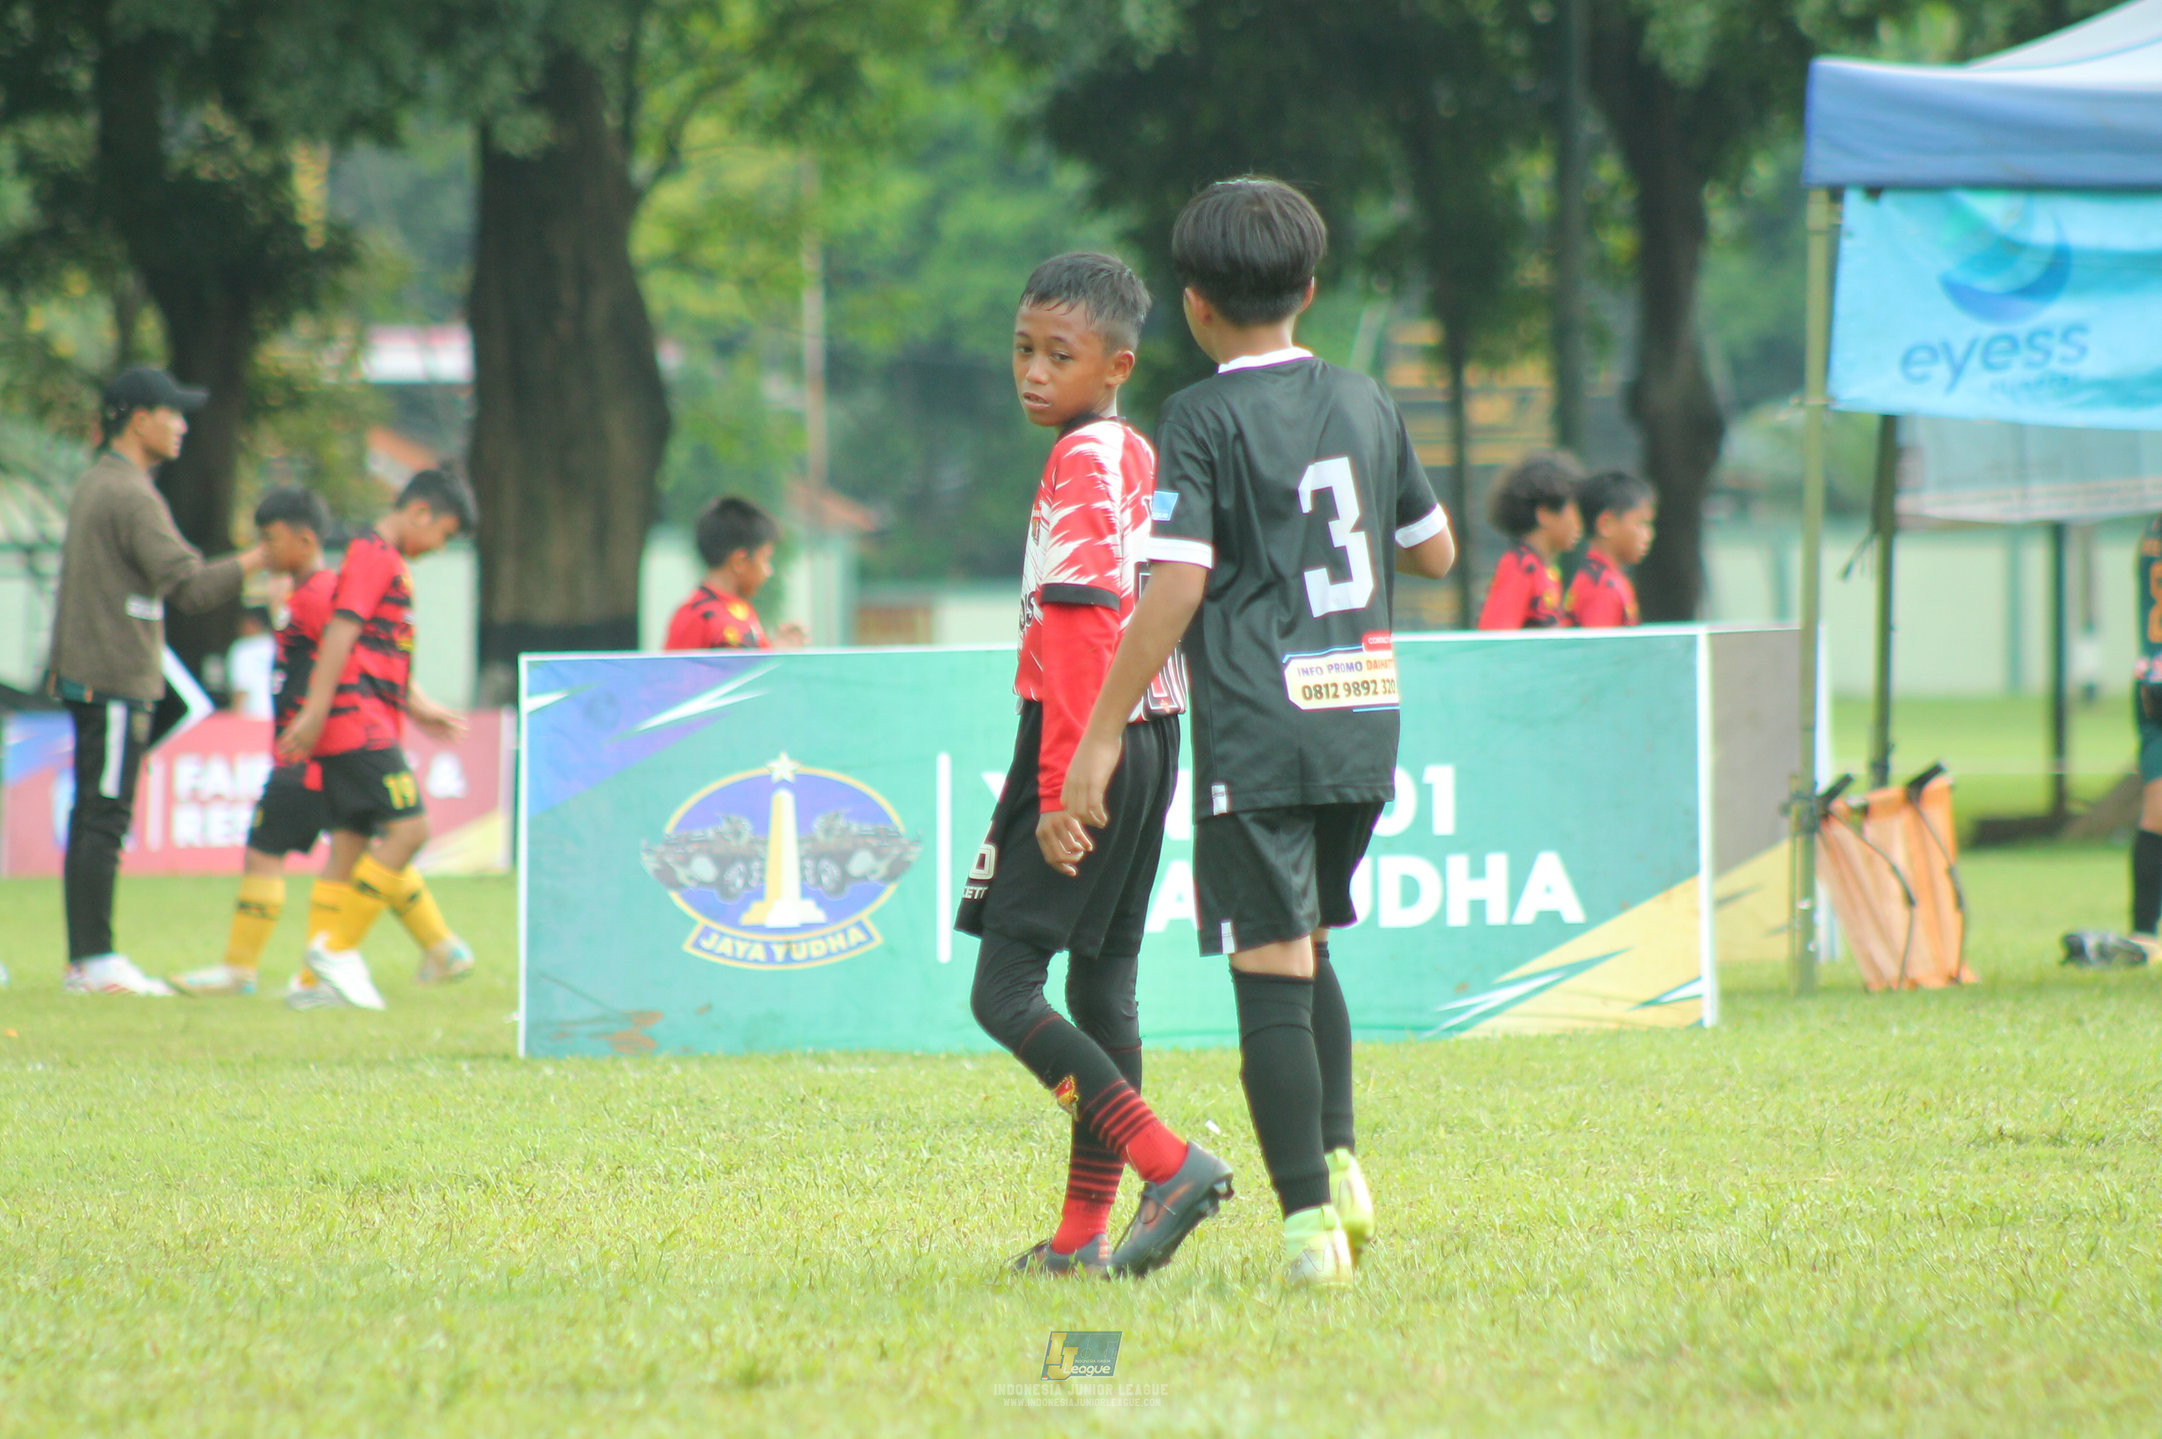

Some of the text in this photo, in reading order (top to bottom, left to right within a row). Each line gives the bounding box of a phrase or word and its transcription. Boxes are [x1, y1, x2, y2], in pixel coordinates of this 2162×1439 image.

[1900, 322, 2093, 393] eyess
[1299, 456, 1375, 618] 3
[1297, 665, 1324, 678] INFO
[1327, 660, 1363, 674] PROMO
[1301, 682, 1340, 701] 0812
[1342, 679, 1379, 697] 9892
[382, 771, 417, 810] 19
[701, 925, 867, 963] JAYA YUDHA
